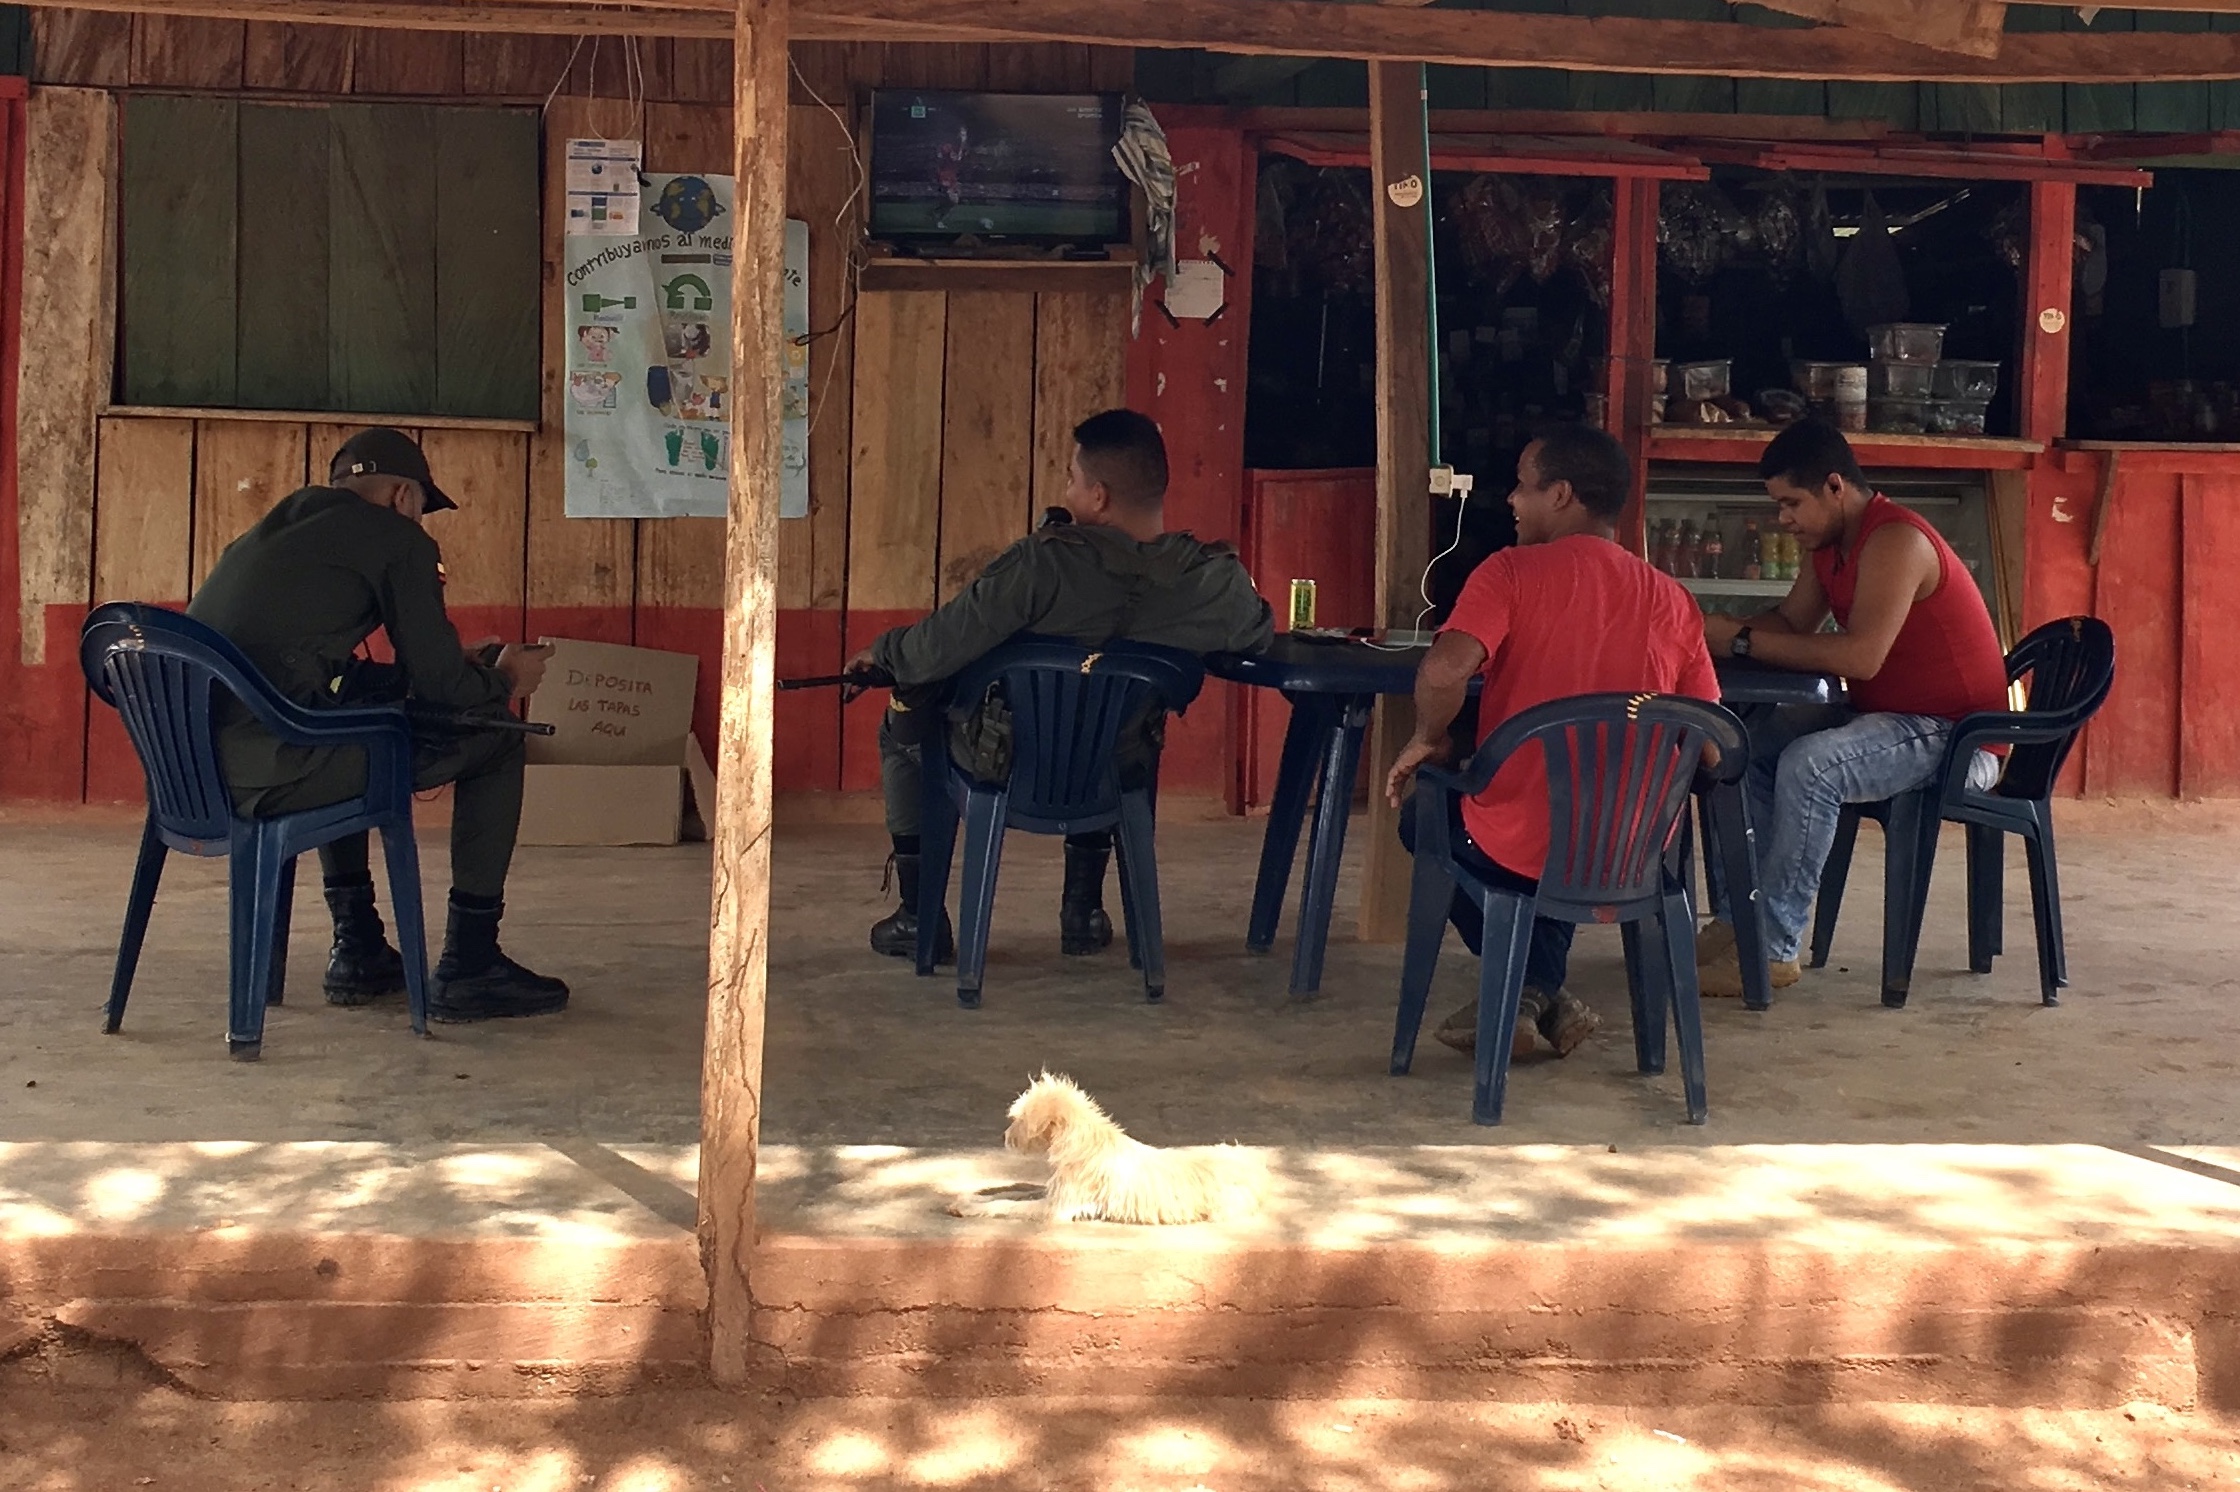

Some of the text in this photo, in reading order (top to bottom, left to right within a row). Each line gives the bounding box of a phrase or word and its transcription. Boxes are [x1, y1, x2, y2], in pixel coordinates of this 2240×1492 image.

[677, 233, 693, 248] al
[699, 235, 734, 250] medi
[568, 697, 641, 717] LAS TAPAS
